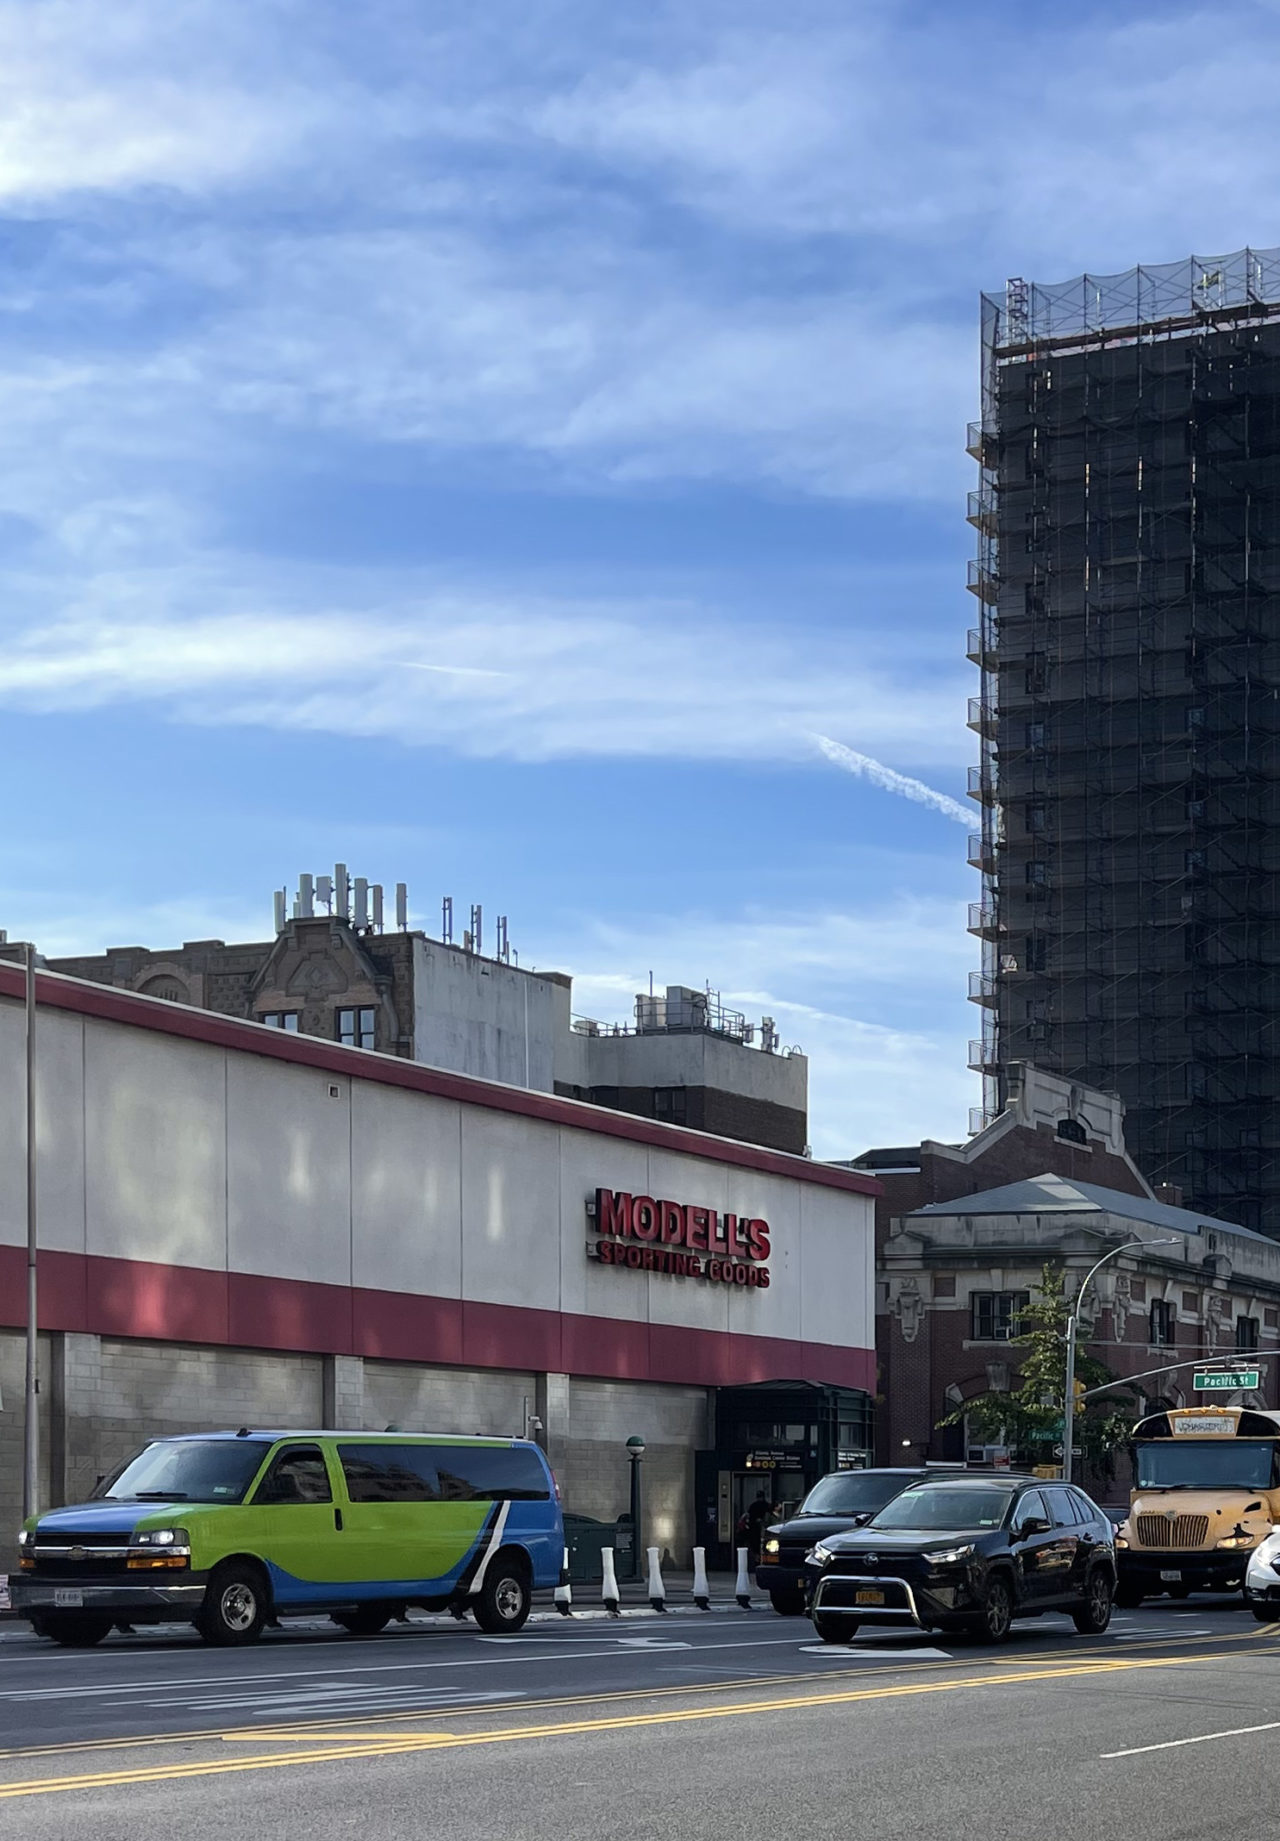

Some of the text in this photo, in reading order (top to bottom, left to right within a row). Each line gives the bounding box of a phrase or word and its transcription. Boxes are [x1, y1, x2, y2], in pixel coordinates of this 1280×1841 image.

[596, 1187, 771, 1260] MODELL'S
[597, 1240, 770, 1288] SPORTING GOODS
[1203, 1376, 1249, 1386] Pacific St
